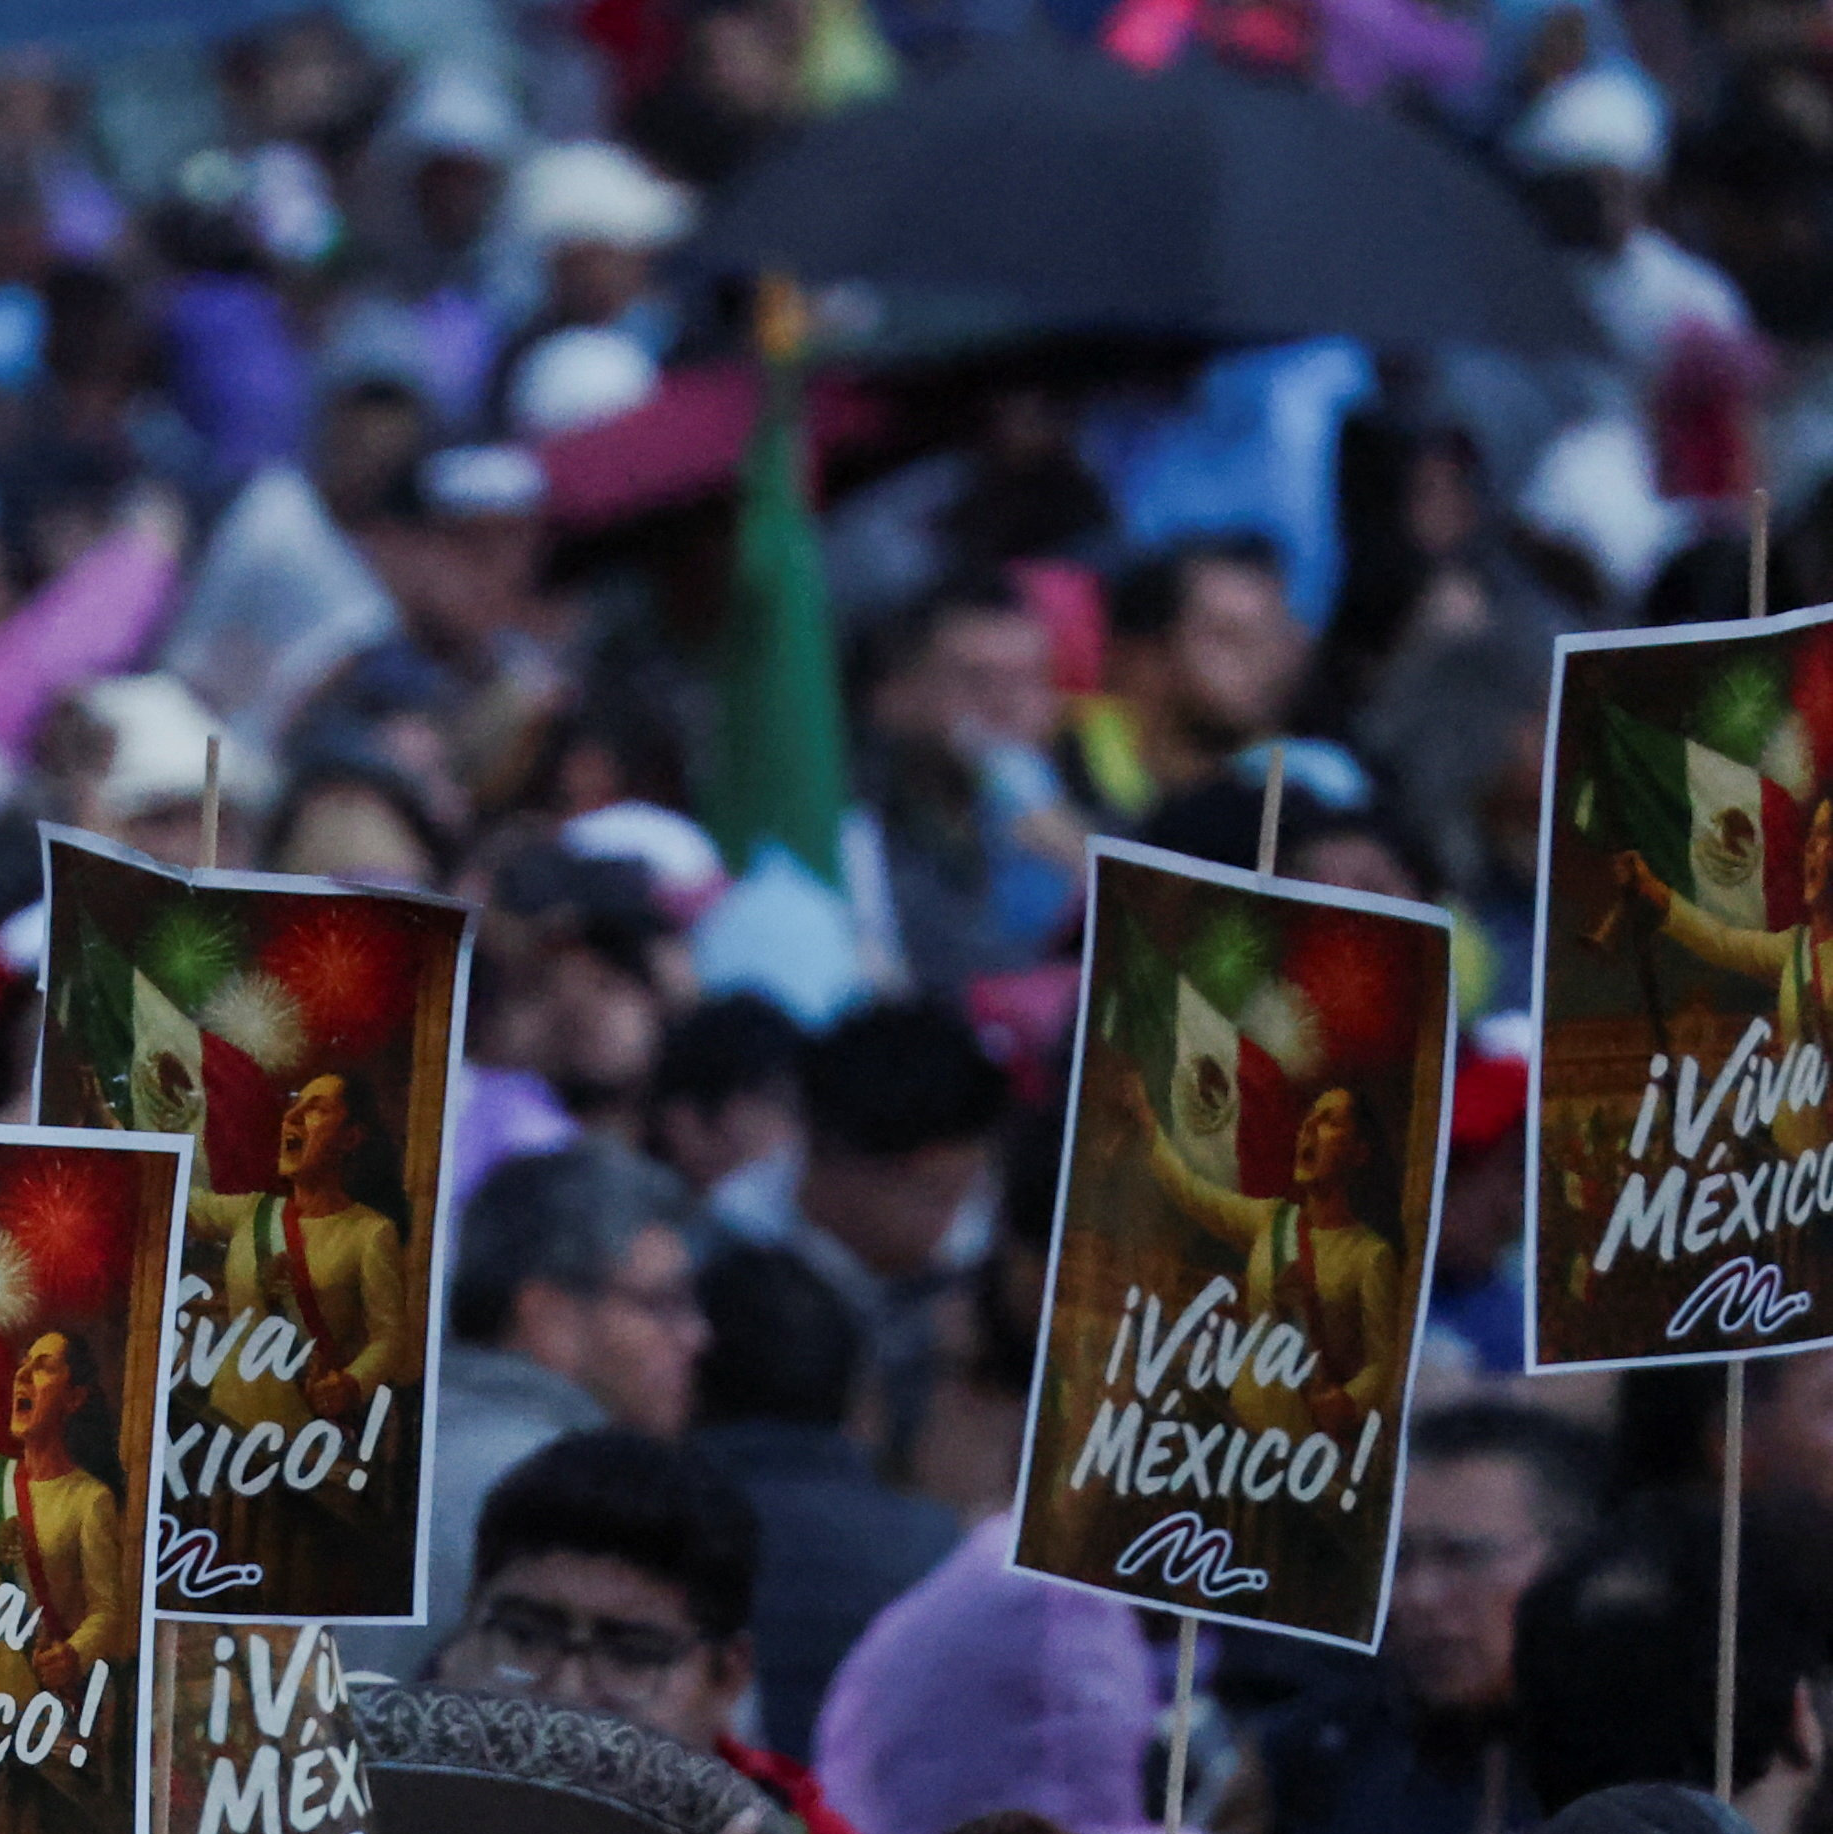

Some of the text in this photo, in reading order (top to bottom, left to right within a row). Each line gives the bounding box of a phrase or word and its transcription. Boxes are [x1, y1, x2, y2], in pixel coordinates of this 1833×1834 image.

[1630, 1017, 1829, 1159] ¡Viva
[1106, 1278, 1320, 1402] ¡Viva
[1072, 1391, 1381, 1509] MÉXICO!
